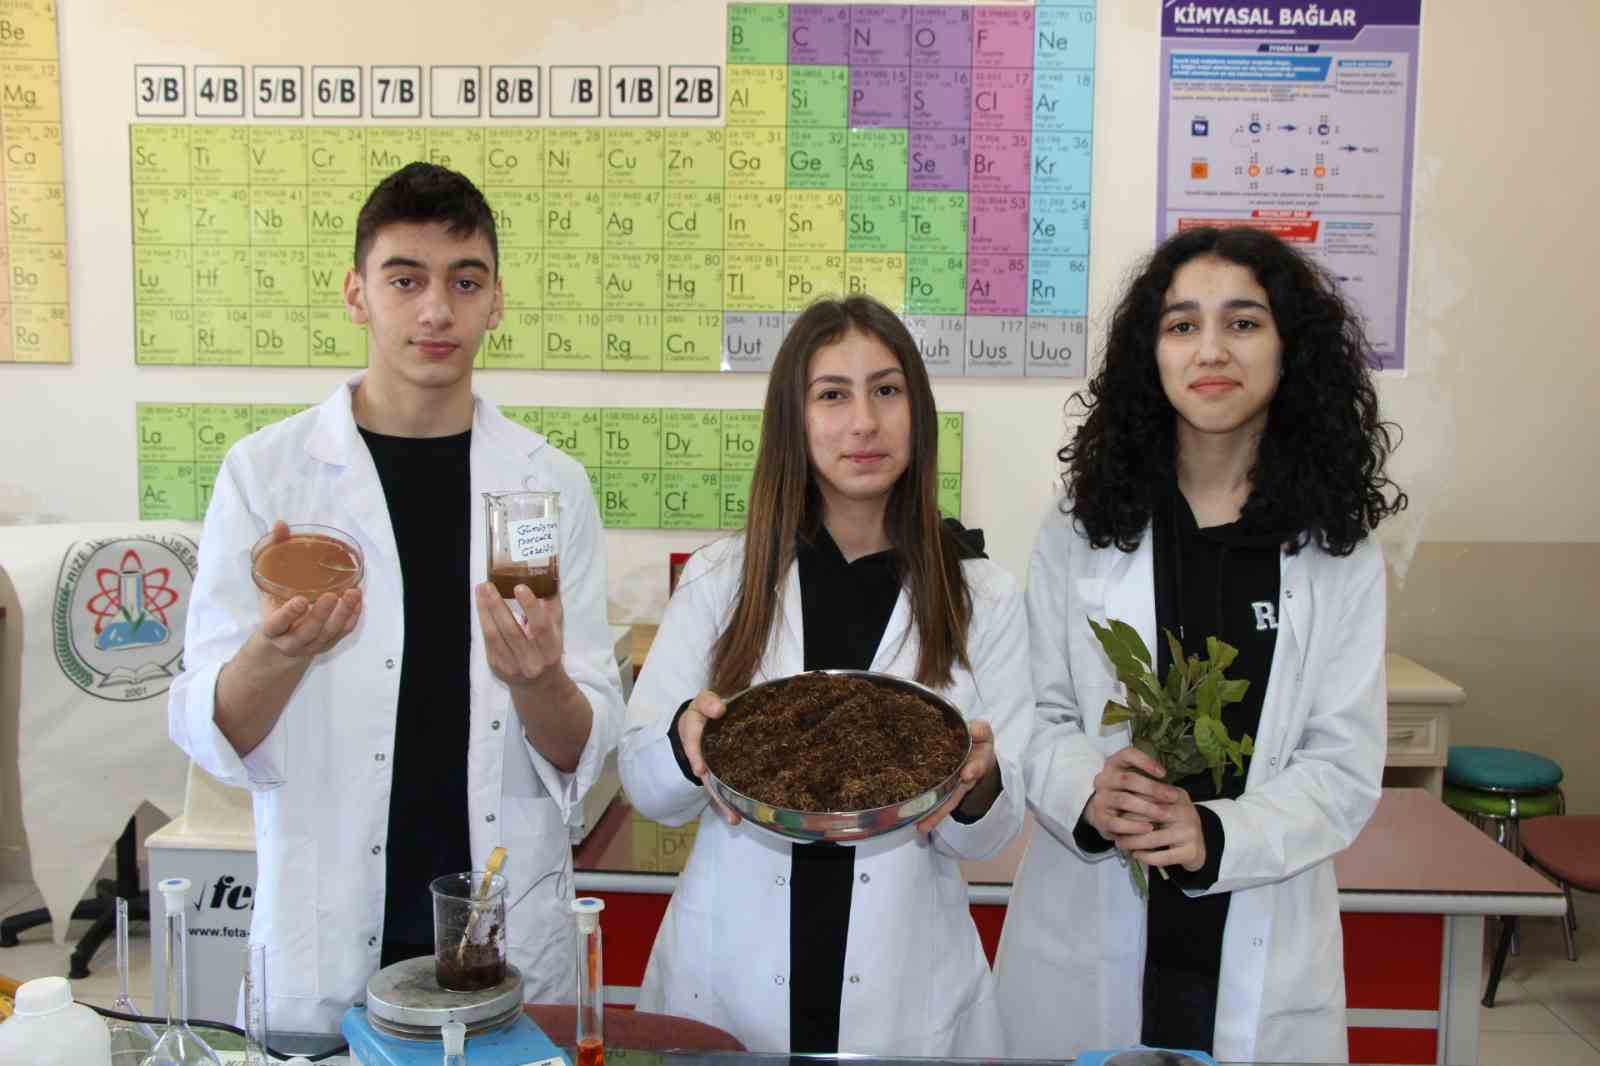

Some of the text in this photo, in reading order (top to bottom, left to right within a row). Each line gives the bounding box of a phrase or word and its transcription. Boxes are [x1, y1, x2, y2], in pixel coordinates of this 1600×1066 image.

[1174, 2, 1356, 26] KİMYASAL BAĞLAR
[0, 21, 25, 40] Be
[732, 27, 743, 44] B
[792, 27, 808, 46] C
[854, 28, 870, 46] N
[915, 28, 935, 47] O
[977, 29, 988, 47] F
[1039, 31, 1067, 50] Ne
[3, 86, 36, 108] Mg
[142, 78, 178, 103] 3/B
[200, 79, 238, 103] 4/B
[259, 79, 296, 103] 5/B
[318, 79, 355, 103] 6/B
[378, 79, 414, 103] 7/B
[496, 79, 533, 104] 8/B
[616, 79, 653, 104] 1/B
[675, 79, 713, 104] 2/B
[729, 90, 749, 107] Al
[792, 90, 808, 108] Si
[853, 91, 865, 108] P
[914, 91, 925, 110] S
[975, 92, 996, 111] Cl
[1036, 94, 1059, 112] Ar
[7, 146, 36, 165] Ca
[136, 148, 157, 166] Sc
[194, 148, 209, 166] Ti
[252, 149, 267, 166] V
[312, 149, 335, 167] Cr
[370, 150, 400, 167] Mn
[430, 149, 451, 166] Fe
[489, 150, 517, 168] Co
[548, 150, 570, 168] Ni
[608, 151, 636, 169] Cu
[668, 151, 693, 169] Zn
[729, 151, 760, 170] Ga
[791, 152, 822, 171] Ge
[851, 152, 874, 171] As
[912, 152, 936, 172] Se
[974, 153, 994, 173] Br
[1035, 154, 1056, 175] Kr
[10, 207, 29, 225] Sr
[137, 209, 149, 226] Y
[195, 210, 216, 226] Zr
[254, 209, 282, 227] Nb
[312, 210, 343, 228] Mo
[548, 211, 571, 230] Pd
[608, 212, 633, 233] Ag
[668, 212, 696, 230] Cd
[729, 213, 745, 231] In
[789, 213, 813, 232] Sn
[851, 214, 874, 233] Sb
[911, 215, 931, 234] Te
[1032, 217, 1056, 236] Xe
[13, 267, 38, 286] Ba
[139, 270, 159, 287] Lu
[196, 270, 218, 288] Hf
[254, 271, 274, 288] Ta
[312, 271, 332, 288] W
[548, 273, 565, 290] Pt
[606, 273, 632, 291] Au
[668, 274, 695, 296] Hg
[728, 274, 743, 292] Tl
[788, 275, 813, 295] Pb
[849, 276, 867, 295] Bi
[910, 277, 933, 296] Po
[970, 278, 990, 296] At
[1032, 279, 1056, 298] Rn
[16, 327, 39, 345] Ra
[140, 330, 156, 346] Lr
[198, 329, 215, 347] Rf
[256, 330, 283, 348] Db
[313, 330, 336, 352] Sg
[489, 335, 512, 351] Mt
[548, 335, 571, 352] Ds
[607, 335, 631, 356] Rg
[667, 335, 695, 353] Cn
[728, 336, 761, 354] Uut
[970, 340, 1007, 359] Uus
[1030, 341, 1072, 361] Uuo
[142, 426, 161, 444] La
[199, 426, 225, 444] Ce
[606, 431, 629, 450] Tb
[665, 432, 690, 455] Dy
[726, 432, 754, 452] Ho
[144, 484, 167, 503] Ac
[200, 484, 211, 502] T
[606, 491, 628, 510] Bk
[665, 492, 687, 511] Cf
[725, 493, 745, 512] Es
[210, 875, 254, 910] fe
